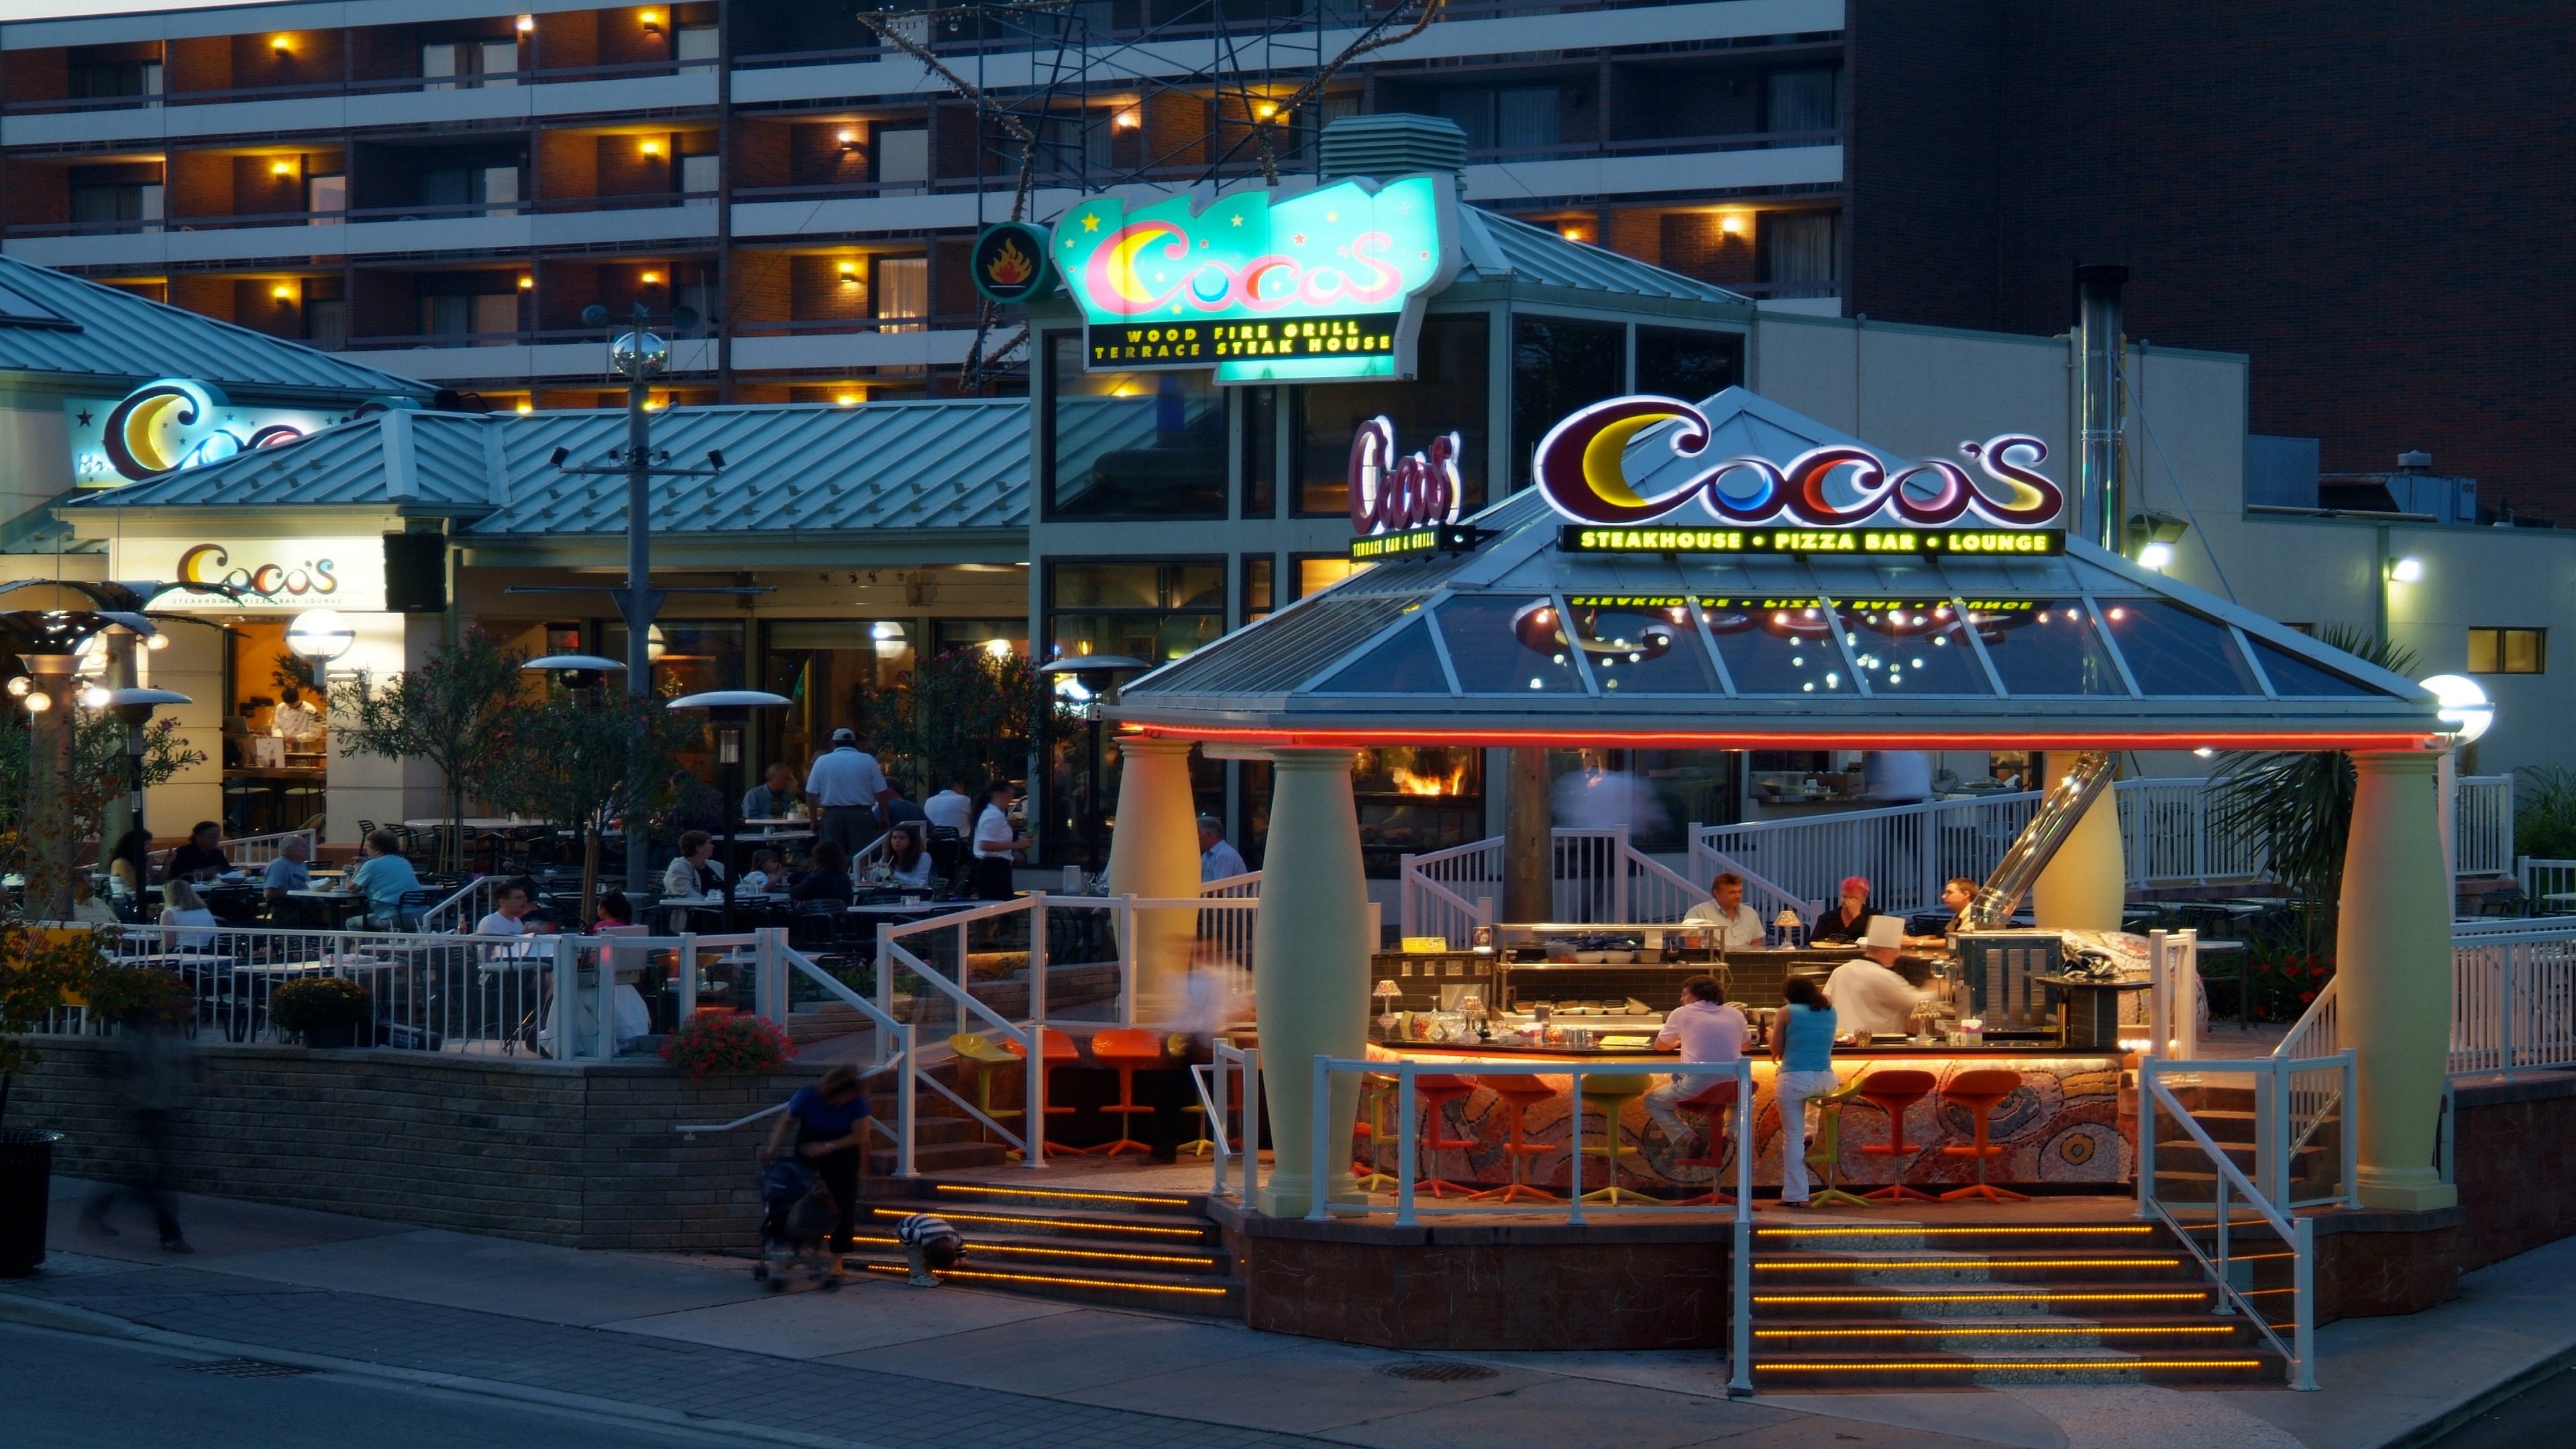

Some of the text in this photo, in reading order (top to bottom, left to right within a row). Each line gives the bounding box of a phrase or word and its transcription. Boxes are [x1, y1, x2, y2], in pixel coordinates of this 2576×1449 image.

[1127, 321, 1359, 343] WOOD FIRE GRILL
[1095, 335, 1390, 360] TERRACE STEAK HOUSE
[1353, 539, 1382, 557] TERRACE
[1412, 531, 1434, 549] GRILL
[1580, 531, 2046, 551] STEAKHOUSE PIZZA BAR LOUNGE
